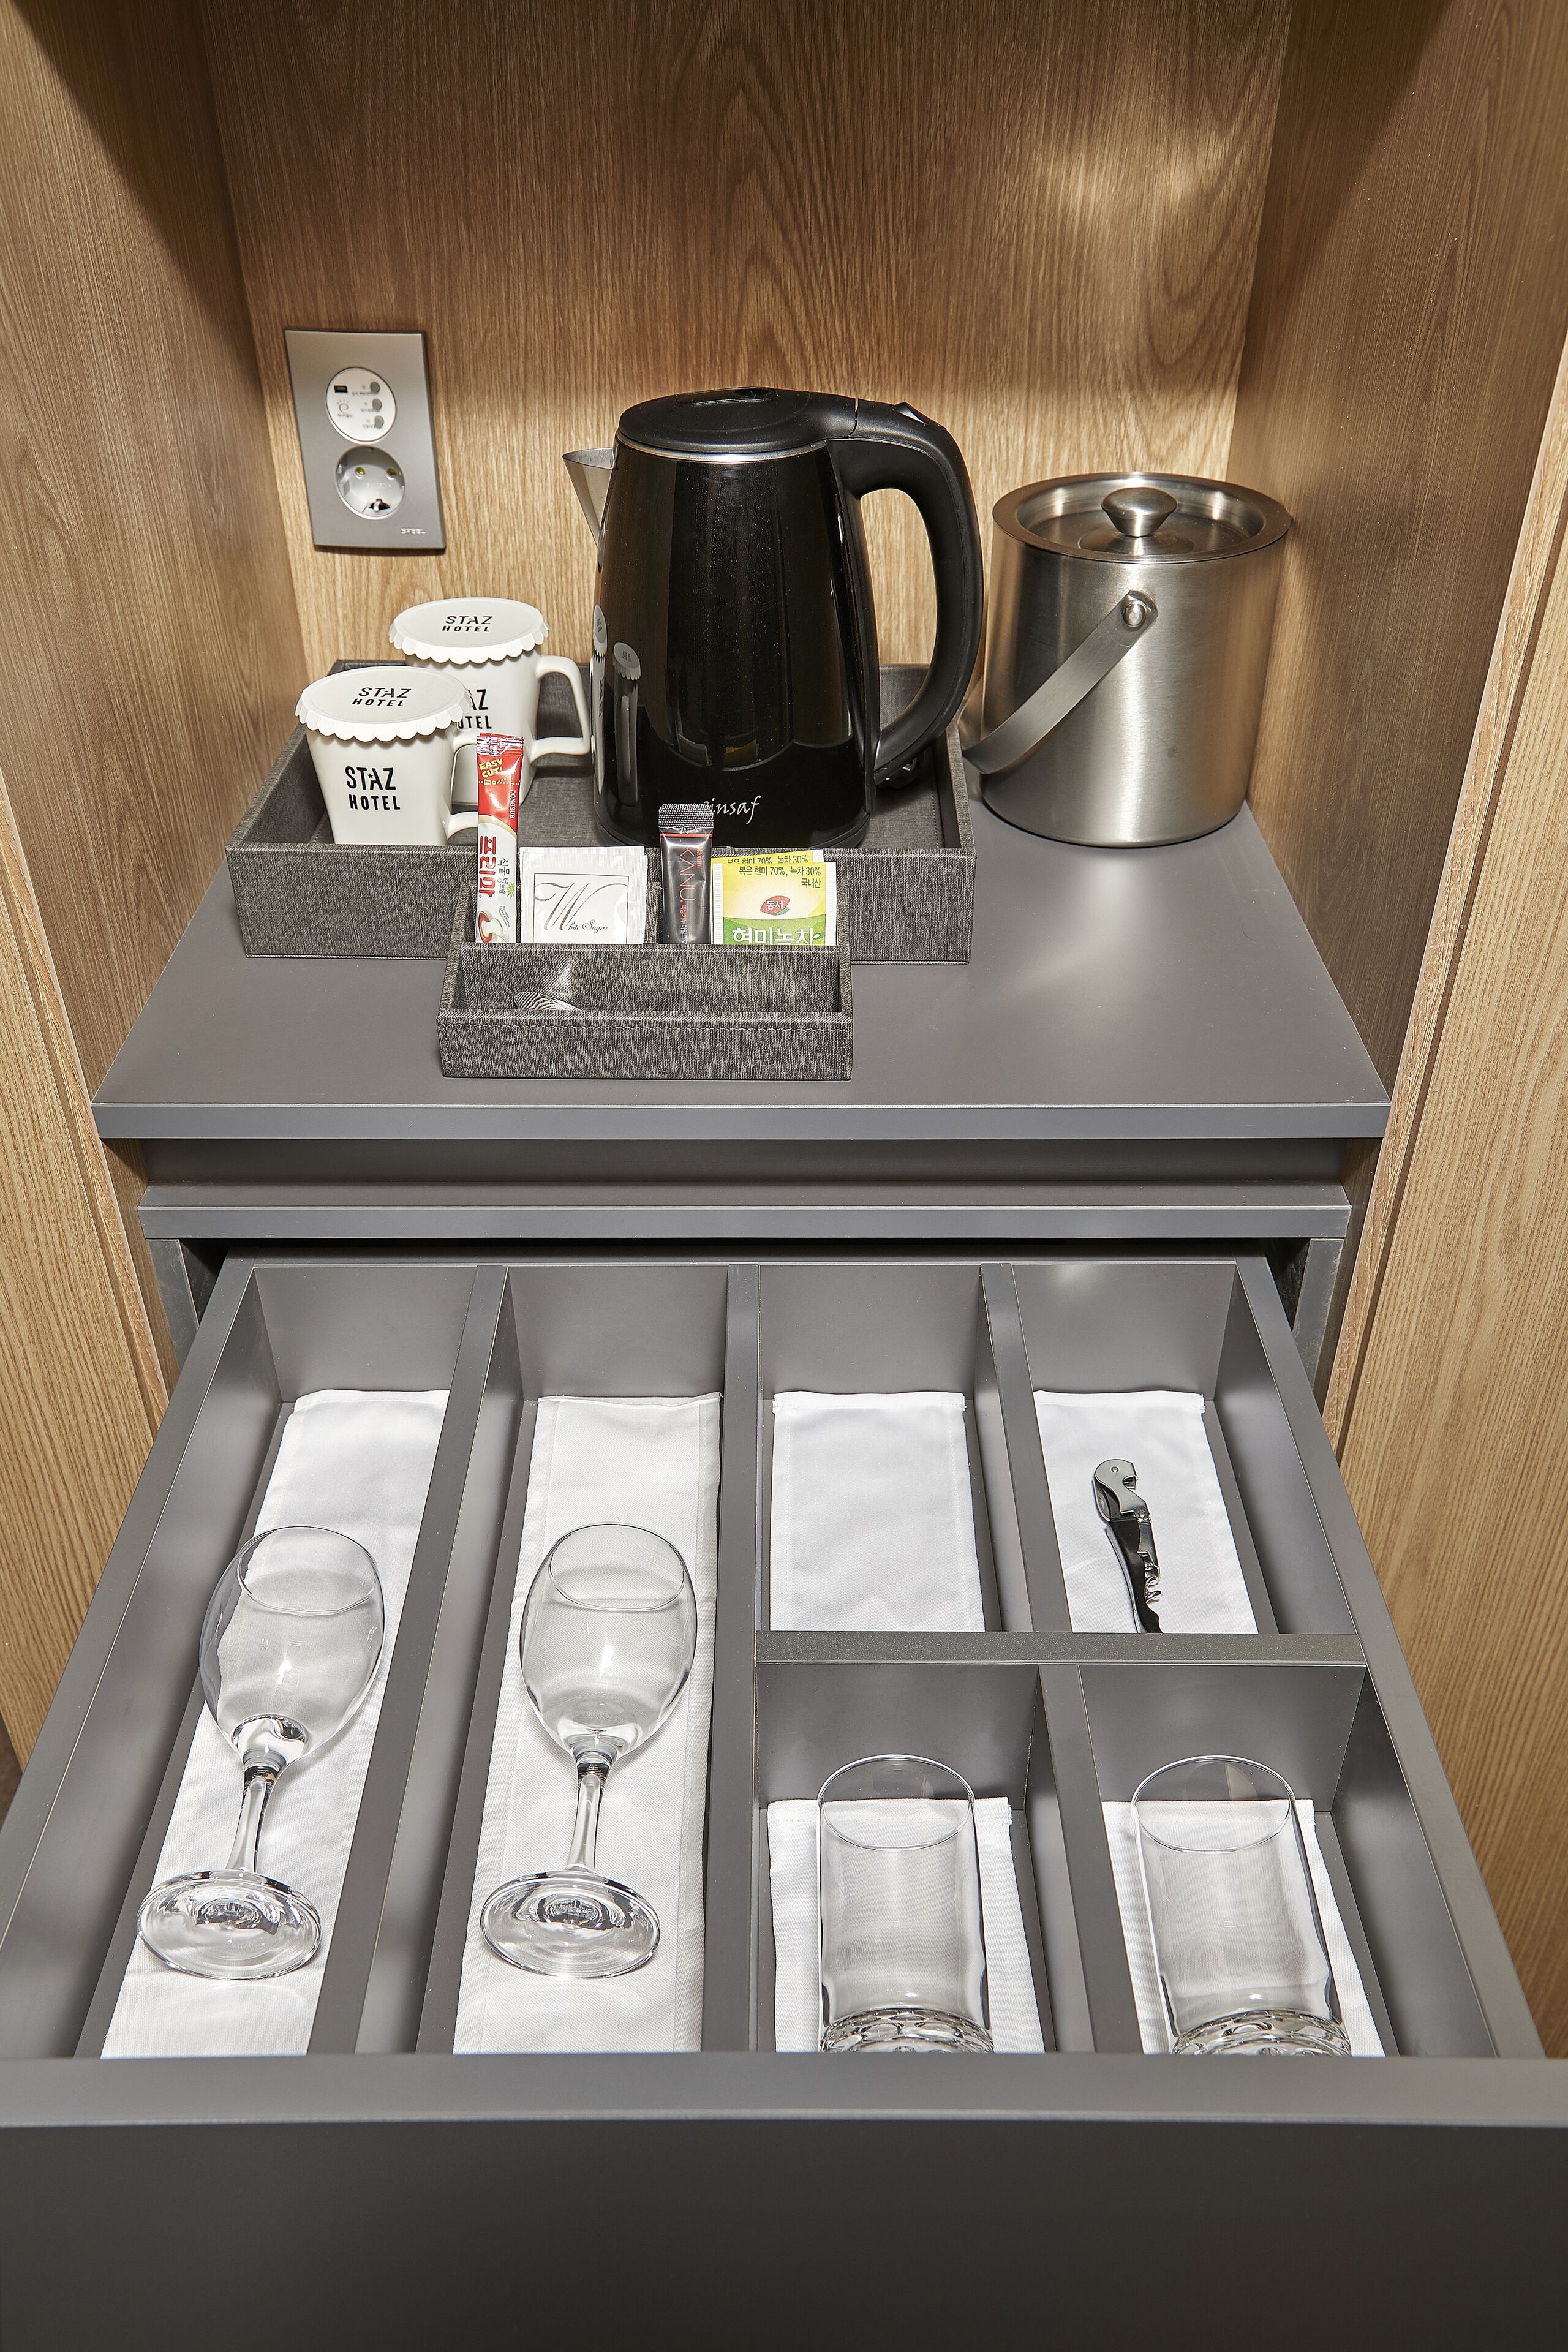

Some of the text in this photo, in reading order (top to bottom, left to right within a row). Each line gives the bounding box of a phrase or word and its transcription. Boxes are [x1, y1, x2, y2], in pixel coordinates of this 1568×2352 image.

[445, 616, 493, 624] STAZ
[358, 687, 412, 698] STAZ
[456, 715, 492, 729] OTEL
[479, 758, 503, 771] EASY
[345, 766, 397, 790] STAZ
[481, 767, 503, 778] CUT!
[349, 794, 401, 810] HOTEL
[704, 795, 761, 825] insaf
[739, 866, 821, 877] 볶은 현미 70%, 녹차 30%
[801, 878, 821, 889] 국내산
[766, 900, 783, 910] 동서
[582, 919, 608, 934] Sugar
[732, 926, 820, 945] 현미녹차
